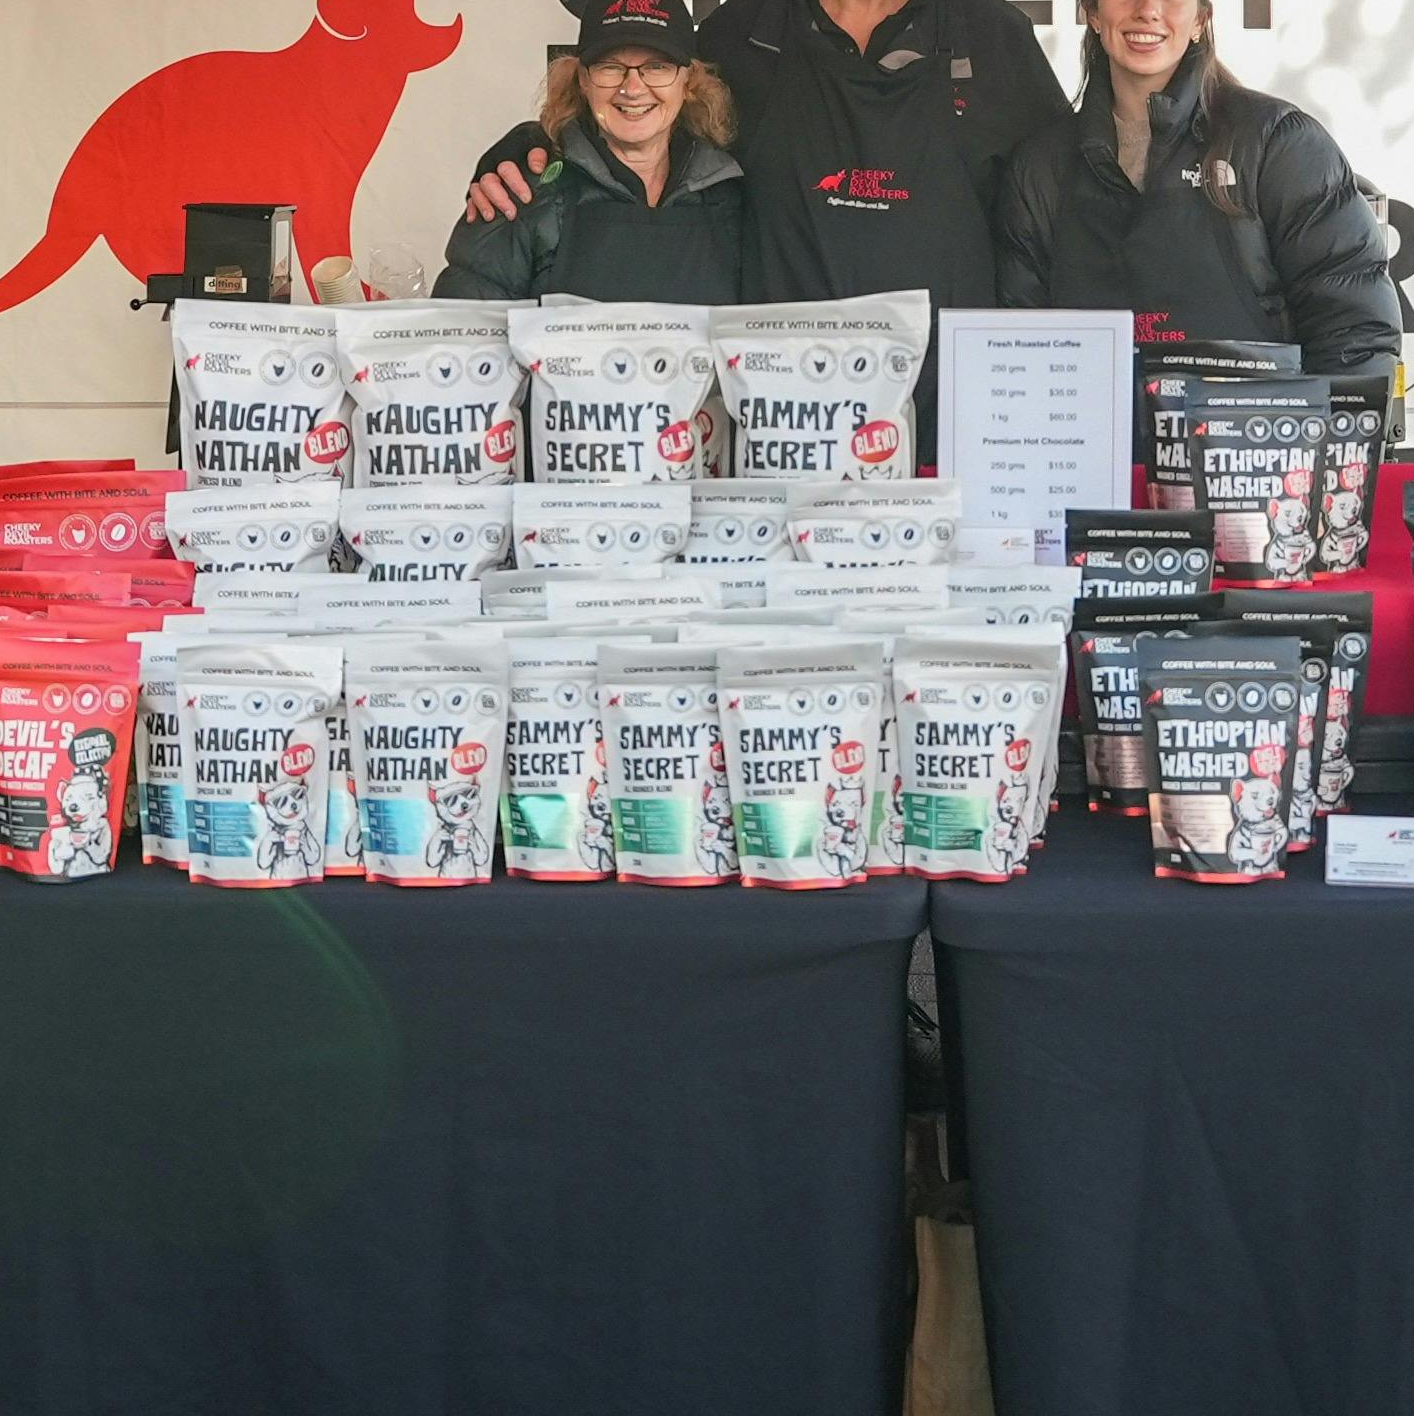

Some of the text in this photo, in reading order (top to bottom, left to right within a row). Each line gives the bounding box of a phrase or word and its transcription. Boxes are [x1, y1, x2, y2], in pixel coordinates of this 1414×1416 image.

[850, 177, 881, 190] DEVIL
[851, 168, 895, 181] CHEEKY
[849, 186, 910, 200] ROASTERS
[745, 351, 782, 361] CHEEKY
[987, 339, 1082, 349] Fresh Roasted Coffee
[204, 352, 241, 362] CHEEKY
[745, 363, 794, 374] ROASTERS
[1048, 364, 1078, 374] $20.00
[204, 365, 252, 376] ROASTERS
[990, 364, 1027, 375] 250 gms
[990, 388, 1027, 399] 500 gms
[1048, 388, 1078, 398] $35.00
[195, 400, 322, 432] NAUGHTY
[366, 400, 499, 436] NAUGHTY
[545, 399, 670, 432] SAMMY'S
[739, 397, 867, 431] SAMMY'S
[997, 413, 1009, 424] kg
[307, 424, 348, 458] BLEND
[854, 425, 899, 456] BLEND
[982, 437, 1085, 447] Premium Hot Chocolate
[196, 440, 301, 474] NATHAN
[369, 441, 481, 476] NATHAN
[546, 440, 645, 474] SECRET
[744, 439, 838, 471] SECRET
[989, 461, 1026, 473] 250 gms
[1048, 461, 1078, 471] $15.00
[989, 485, 1026, 497] 500 gms
[1048, 485, 1077, 495] $25.00
[1204, 475, 1284, 499] WASHED
[3, 522, 42, 533] CHEEKY
[997, 510, 1008, 522] kg
[3, 530, 33, 539] DEVIL
[3, 535, 53, 546] ROASTERS
[194, 727, 297, 752] NAUGHTY
[364, 725, 467, 750] NAUGHTY
[506, 718, 603, 746] SAMMY'S
[619, 723, 720, 750] SAMMY'S
[739, 725, 842, 754] SAMMY'S
[915, 720, 1017, 748] SAMMY'S
[195, 759, 280, 784] NATHAN
[365, 757, 448, 782] NATHAN
[507, 750, 586, 777] SECRET
[622, 755, 700, 781] SECRET
[741, 756, 823, 785] SECRET
[915, 753, 995, 778] SECRET
[1158, 751, 1250, 778] WASHED
